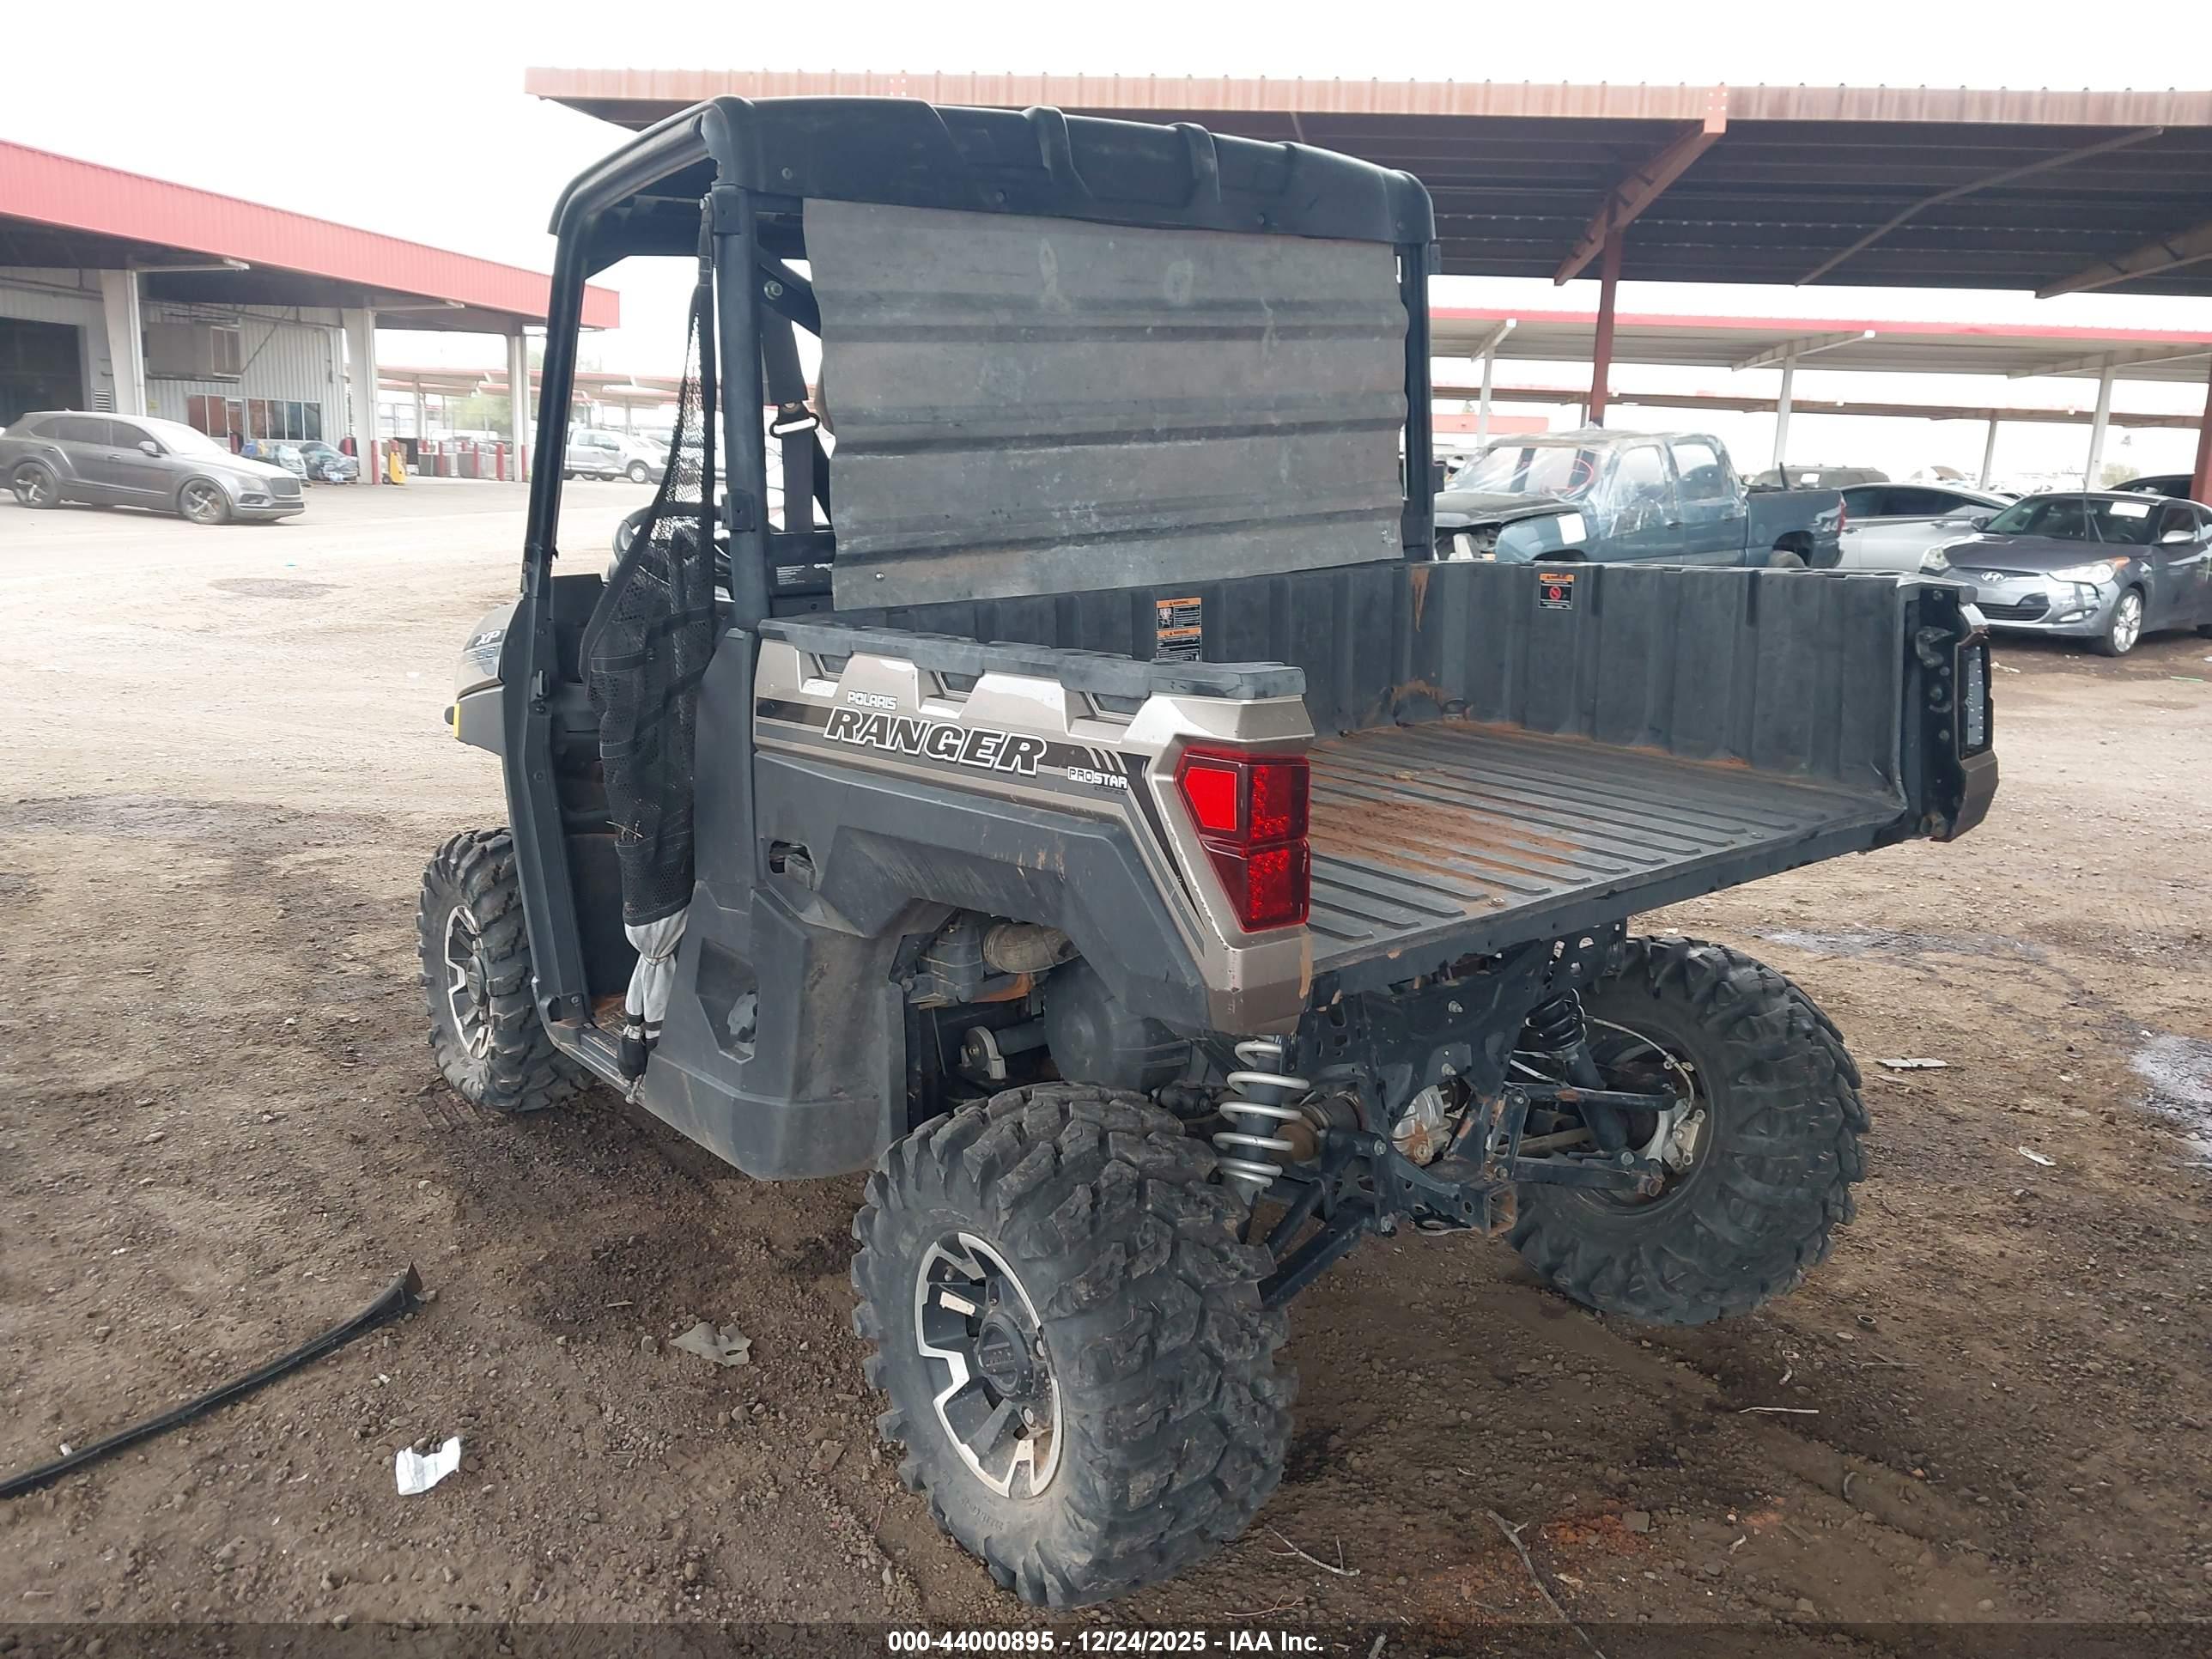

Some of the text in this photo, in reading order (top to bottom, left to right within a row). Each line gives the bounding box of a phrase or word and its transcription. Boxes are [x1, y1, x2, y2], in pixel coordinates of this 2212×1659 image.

[475, 630, 501, 646] XP
[847, 690, 898, 710] POLARIS
[823, 706, 1048, 776] RANGER
[1067, 766, 1128, 790] PROSTAR
